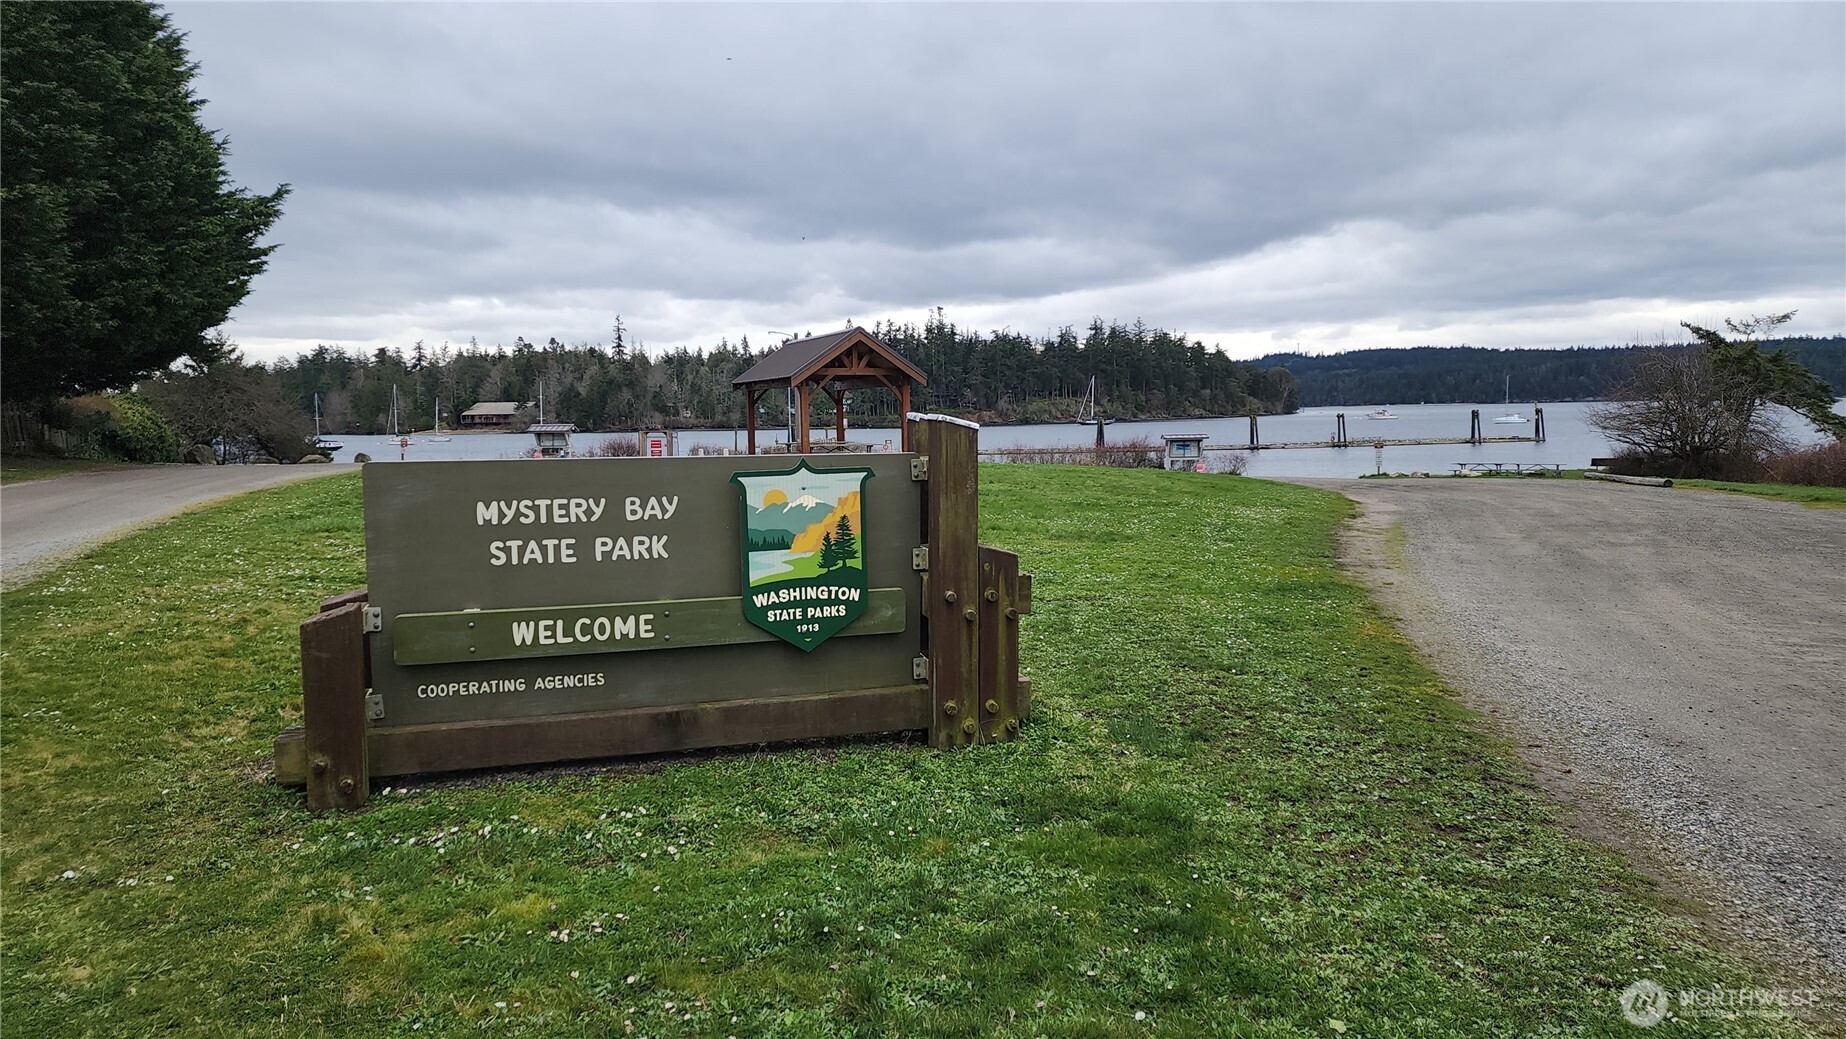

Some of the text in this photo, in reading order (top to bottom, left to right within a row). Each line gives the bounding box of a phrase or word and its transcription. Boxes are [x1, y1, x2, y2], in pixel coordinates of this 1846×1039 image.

[475, 494, 680, 527] MYSTERY BAY
[488, 534, 670, 567] STATE PARK
[751, 585, 861, 608] WASHINGTON
[767, 604, 847, 622] STATE PARKS
[510, 612, 656, 647] WELCOME
[796, 623, 820, 633] 1913
[416, 672, 606, 699] COOPERATING AGENCIES
